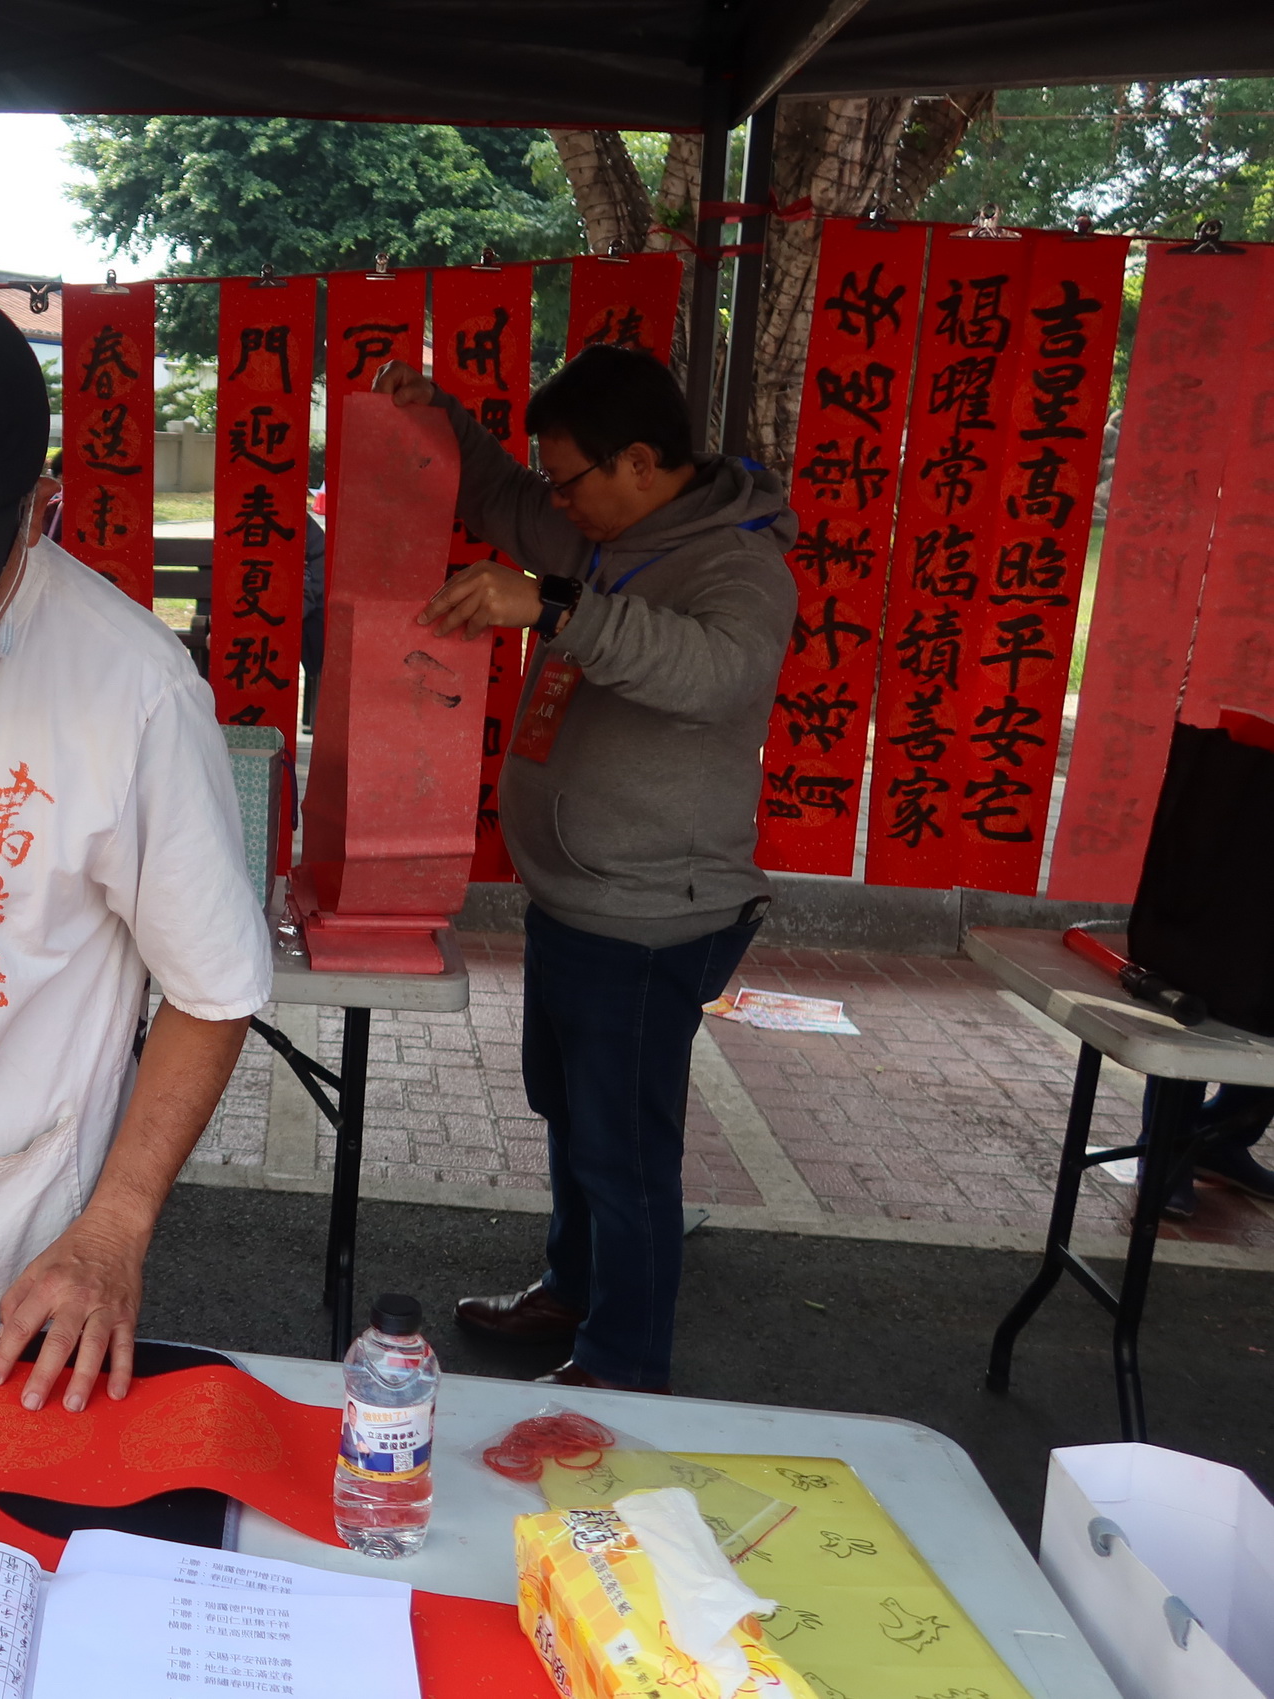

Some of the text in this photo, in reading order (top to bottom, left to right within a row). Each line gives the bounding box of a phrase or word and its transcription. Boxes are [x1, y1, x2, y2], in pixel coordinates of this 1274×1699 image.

[962, 279, 1101, 843] 吉星高照平安宅
